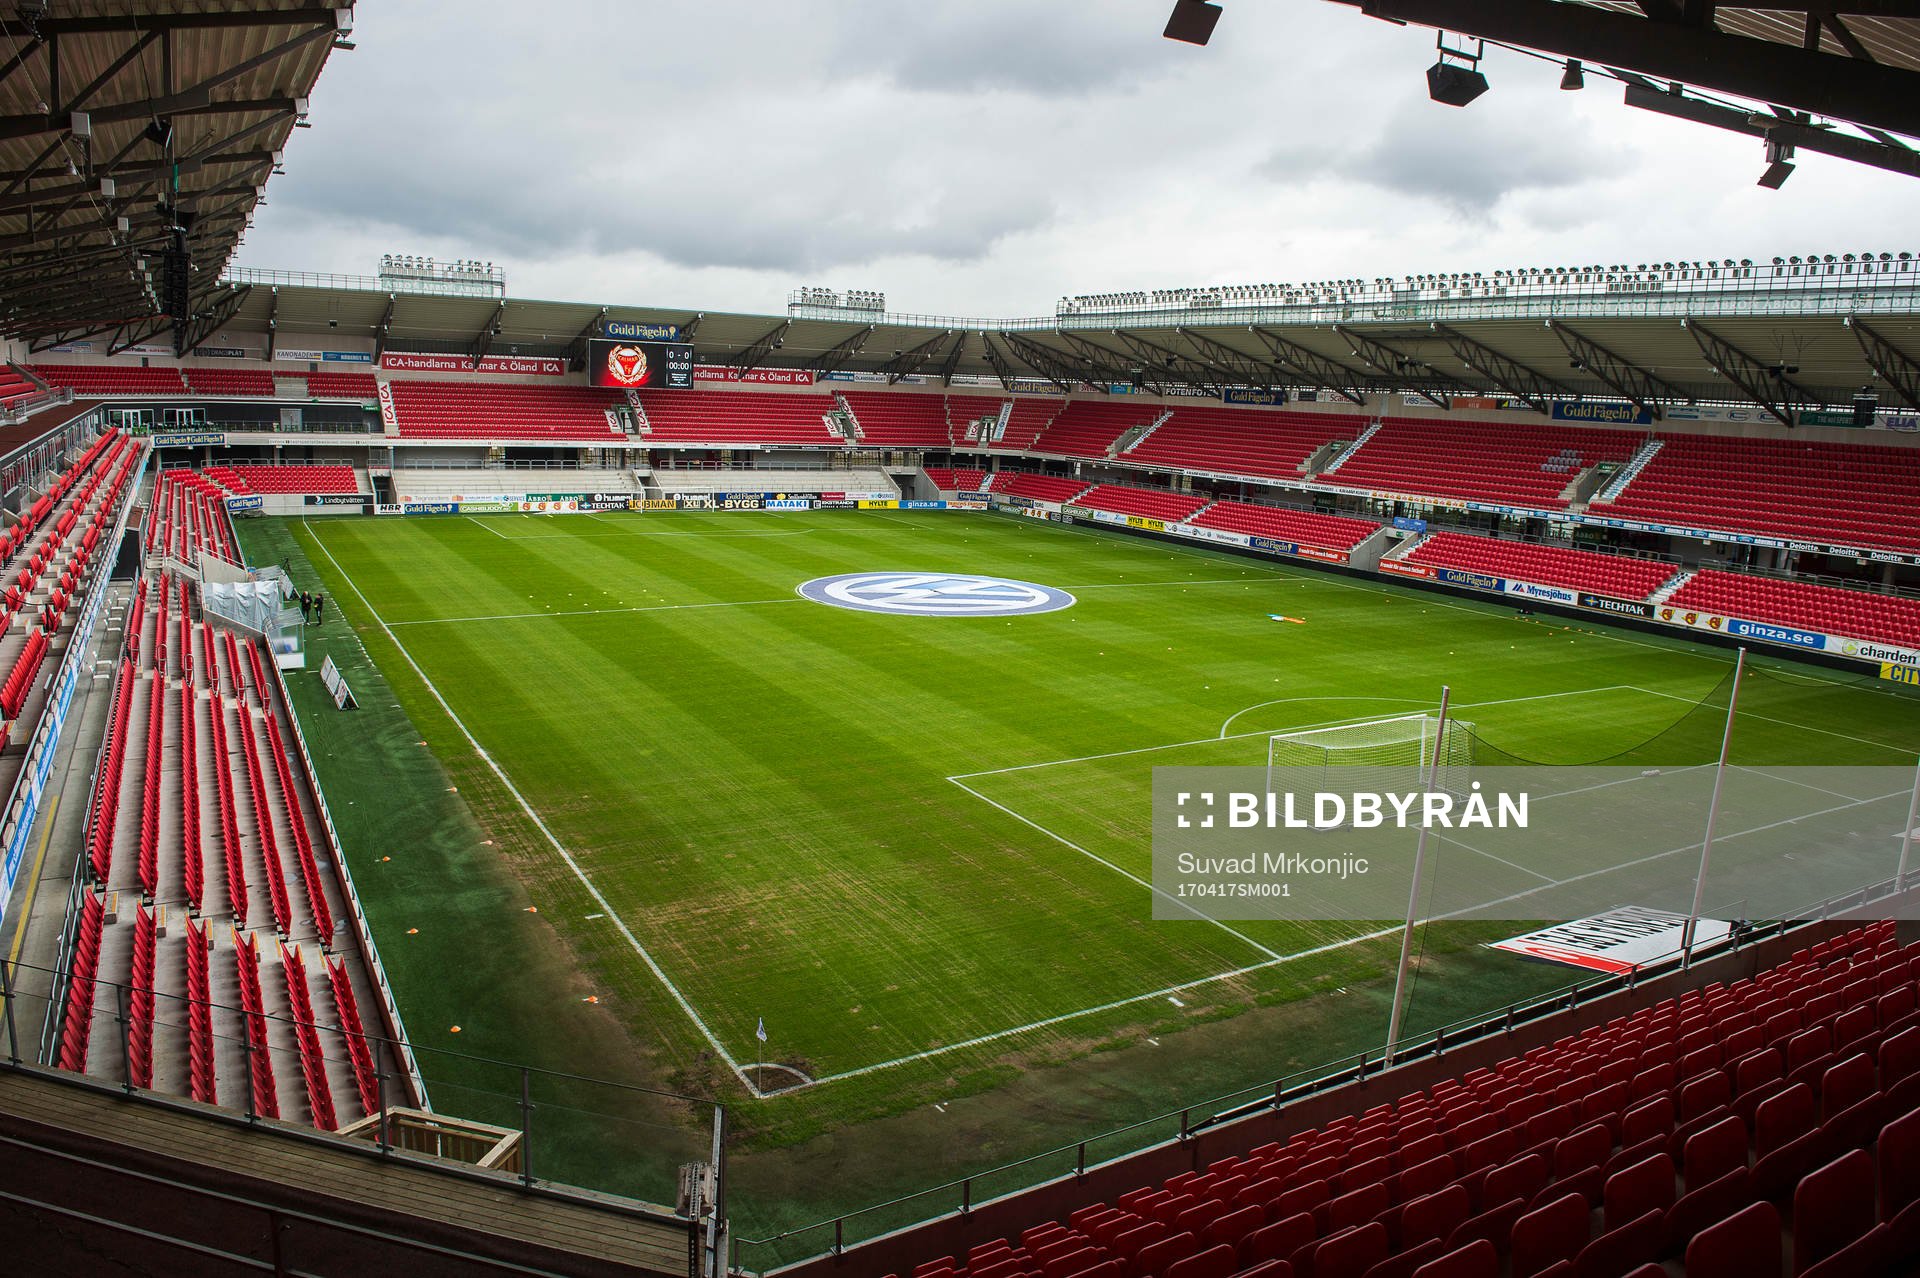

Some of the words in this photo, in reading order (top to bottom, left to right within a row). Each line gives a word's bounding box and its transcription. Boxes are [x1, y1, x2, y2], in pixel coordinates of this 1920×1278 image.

[609, 323, 634, 336] Guld
[636, 324, 669, 339] Fägeln
[386, 358, 456, 368] ICA-handlarna
[462, 362, 496, 370] Kamar
[500, 362, 508, 370] &
[510, 361, 538, 372] Öland
[544, 364, 560, 372] ICA
[760, 372, 766, 381] &
[768, 372, 790, 382] Öland
[796, 374, 810, 382] ICA
[380, 384, 390, 403] ICA
[1009, 382, 1032, 392] Guld
[1033, 383, 1061, 394] Fägeln
[1231, 392, 1248, 401] Guld
[1250, 392, 1270, 405] Fägeln
[385, 405, 394, 424] ICA
[1564, 404, 1594, 418] Guld
[1595, 404, 1630, 421] Fägeln
[638, 412, 648, 428] ICA
[156, 436, 170, 444] Guld
[171, 436, 187, 445] Fägeln
[191, 435, 205, 444] Guld
[206, 435, 220, 444] Fägeln
[243, 500, 258, 508] Fägeln
[424, 504, 446, 514] Fägeln
[704, 500, 759, 508] XL-BYGG
[908, 500, 938, 509] ginza.se
[1148, 520, 1164, 528] HYLTE
[1256, 538, 1268, 547] Guld
[1270, 540, 1288, 551] Fägeln
[1447, 571, 1466, 584] Guld
[1466, 574, 1492, 588] Fägeln
[1527, 585, 1572, 601] Myresjöhus
[1599, 600, 1644, 615] TECHTAK
[1739, 623, 1814, 644] ginza.se
[1860, 646, 1917, 664] charden
